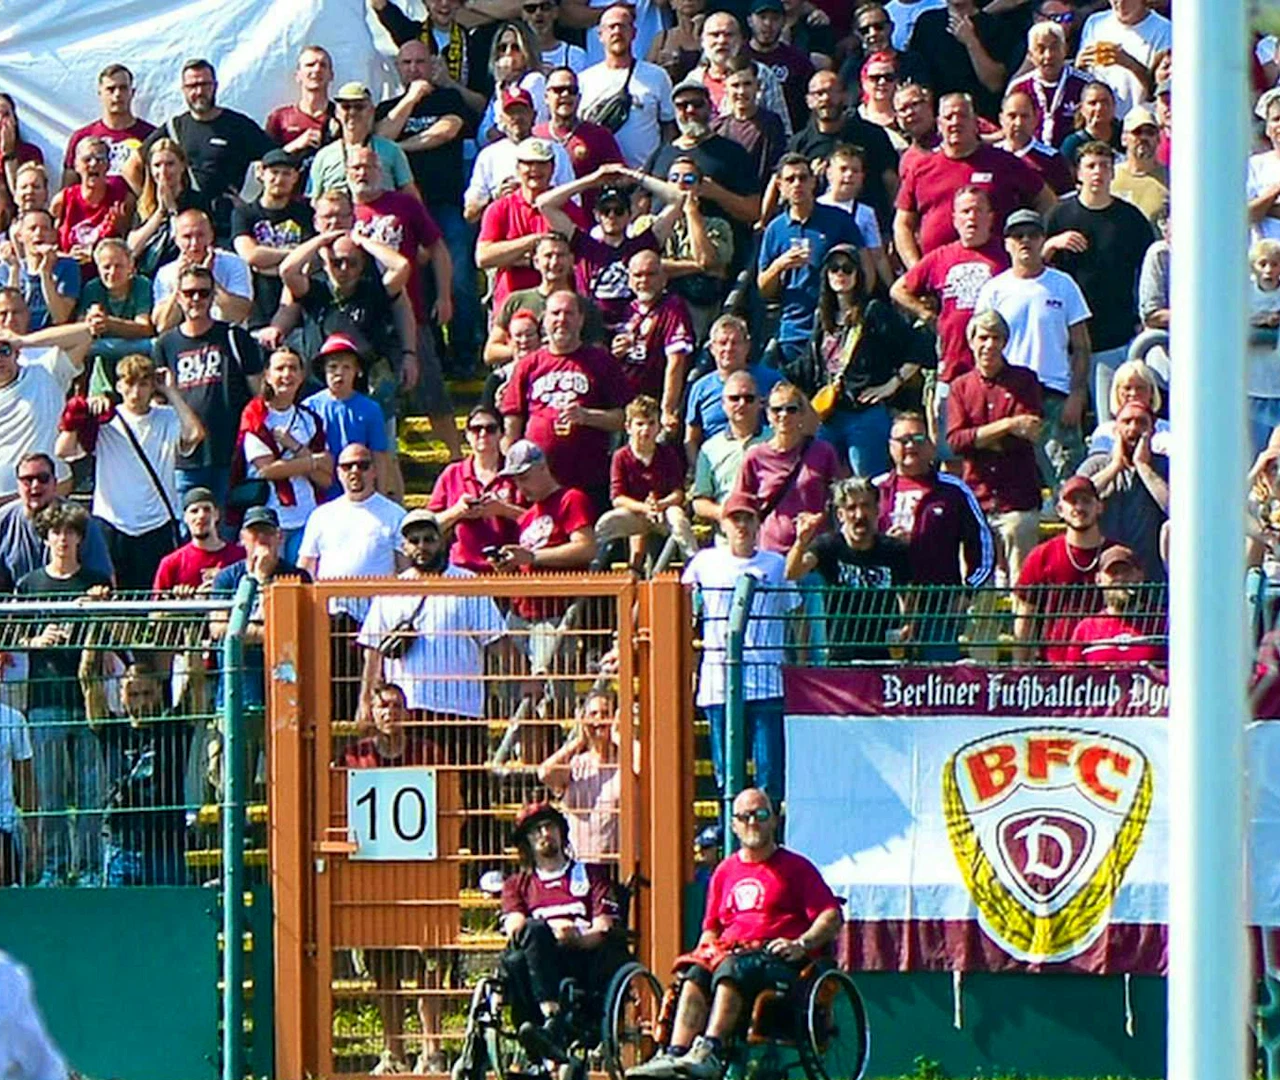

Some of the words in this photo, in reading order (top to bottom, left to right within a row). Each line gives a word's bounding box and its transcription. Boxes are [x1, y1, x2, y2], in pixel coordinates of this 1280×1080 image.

[881, 673, 981, 708] Berliner
[986, 672, 1122, 712] Fußballclub
[965, 737, 1132, 803] BFC
[356, 786, 428, 841] 10
[1013, 816, 1073, 880] D
